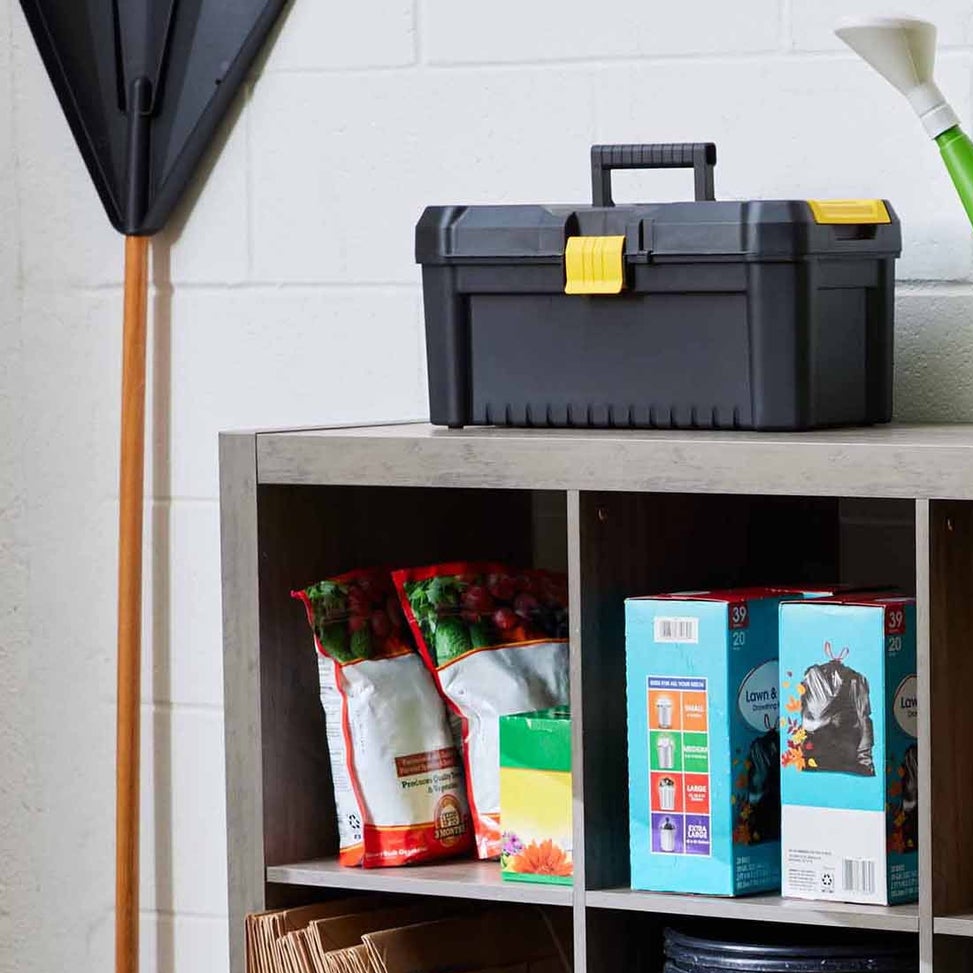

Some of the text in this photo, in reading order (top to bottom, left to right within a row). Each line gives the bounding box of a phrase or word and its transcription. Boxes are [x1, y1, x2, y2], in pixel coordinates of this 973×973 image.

[732, 606, 747, 622] 39
[888, 611, 903, 628] 39
[732, 632, 745, 646] 20
[887, 636, 902, 652] 20
[745, 687, 777, 703] Lawn &
[901, 696, 917, 708] Law
